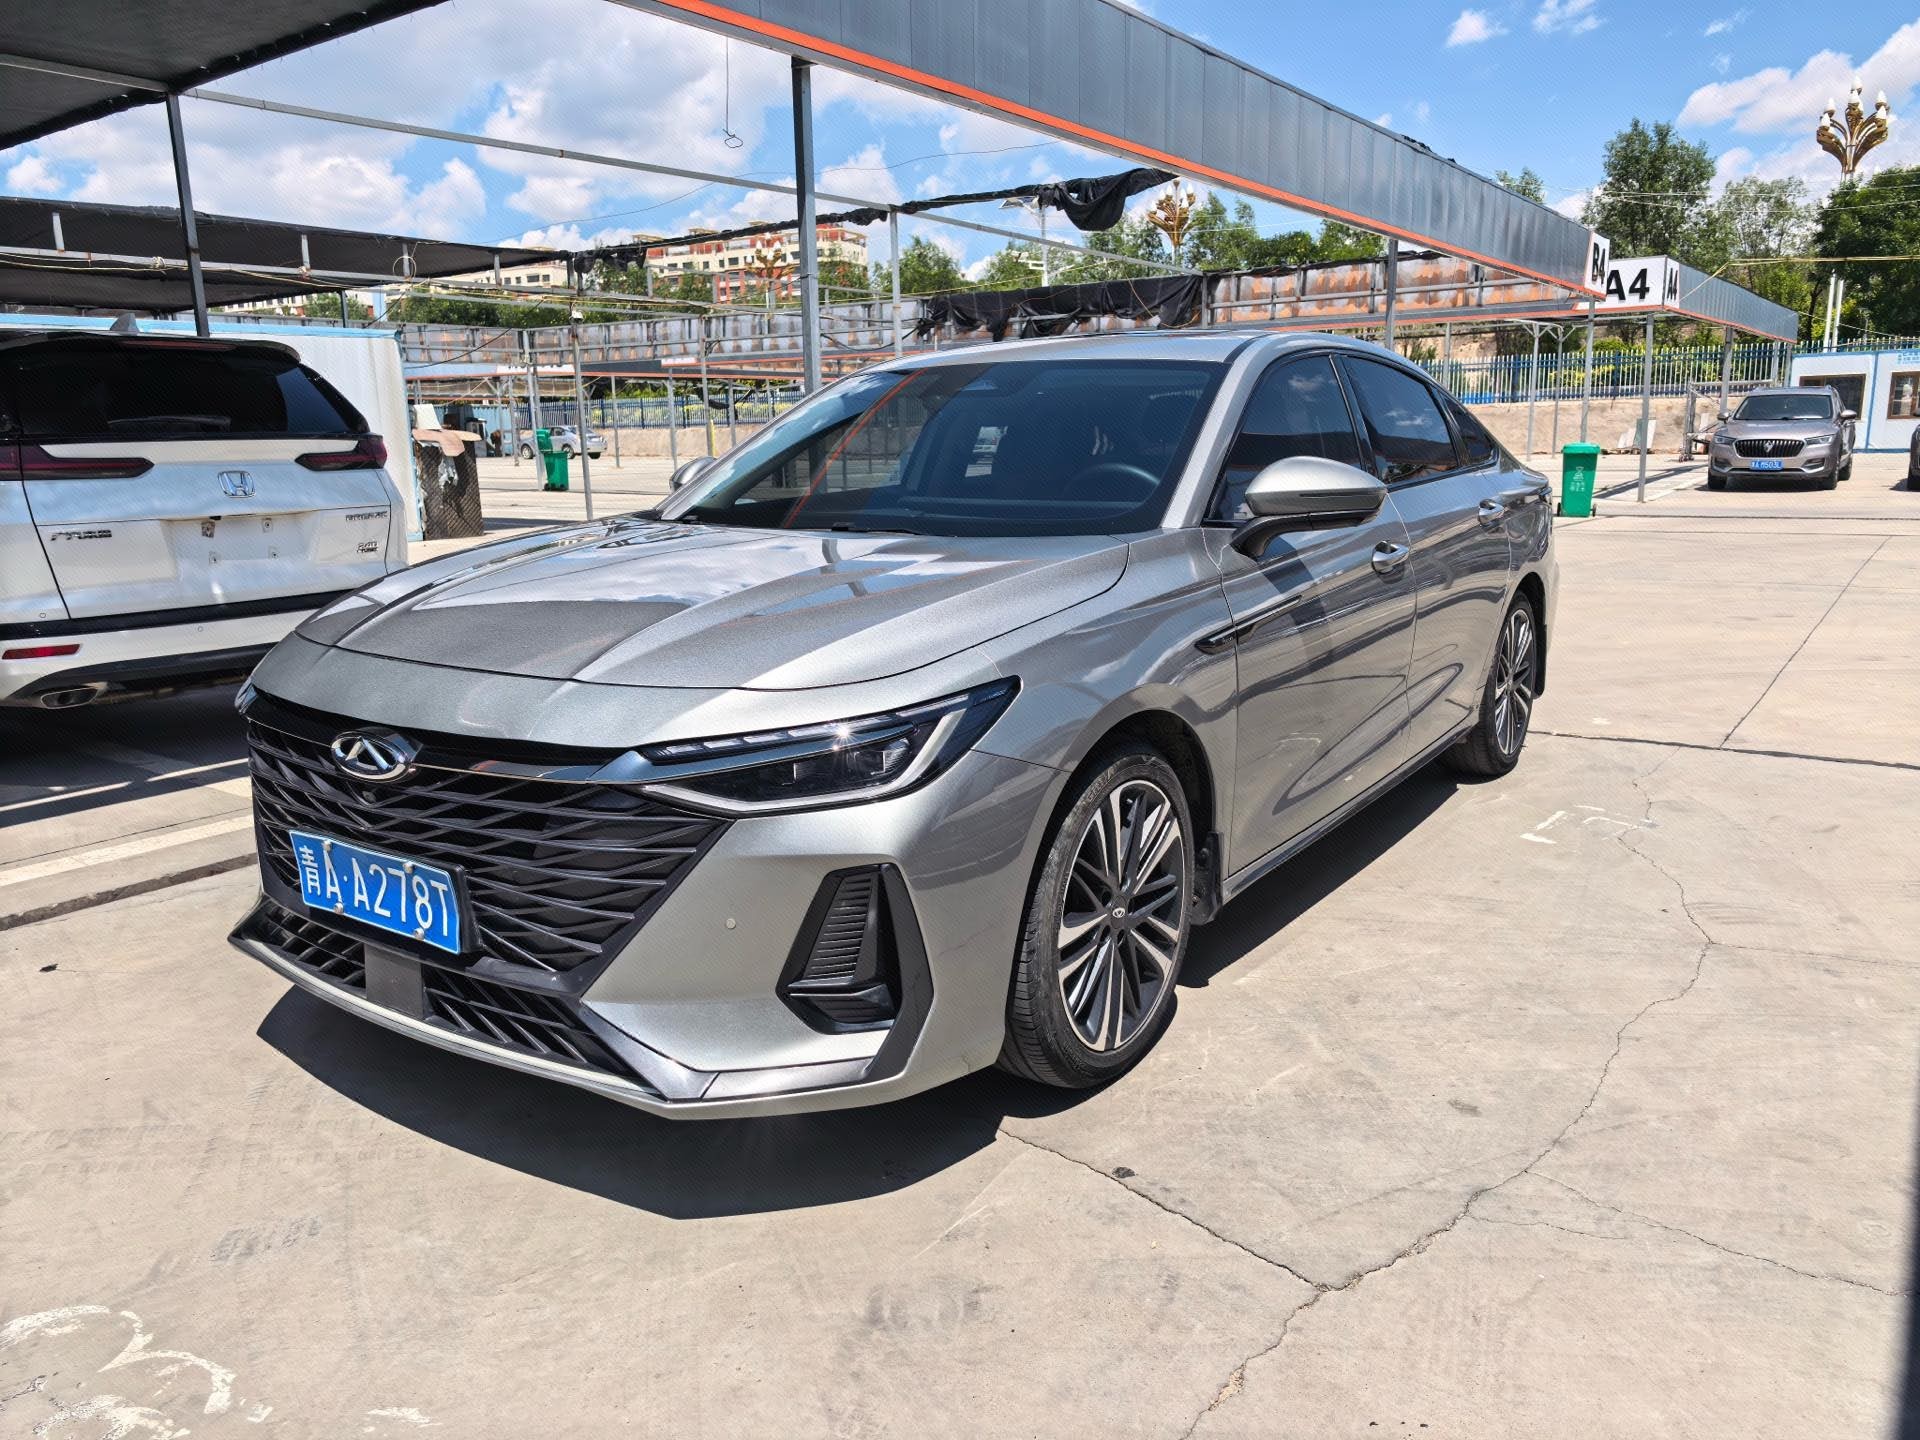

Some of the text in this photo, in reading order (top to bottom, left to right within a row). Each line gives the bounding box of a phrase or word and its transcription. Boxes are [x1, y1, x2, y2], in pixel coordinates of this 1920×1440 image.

[1591, 242, 1606, 285] B4
[1607, 268, 1650, 301] A4
[1667, 267, 1678, 300] A4
